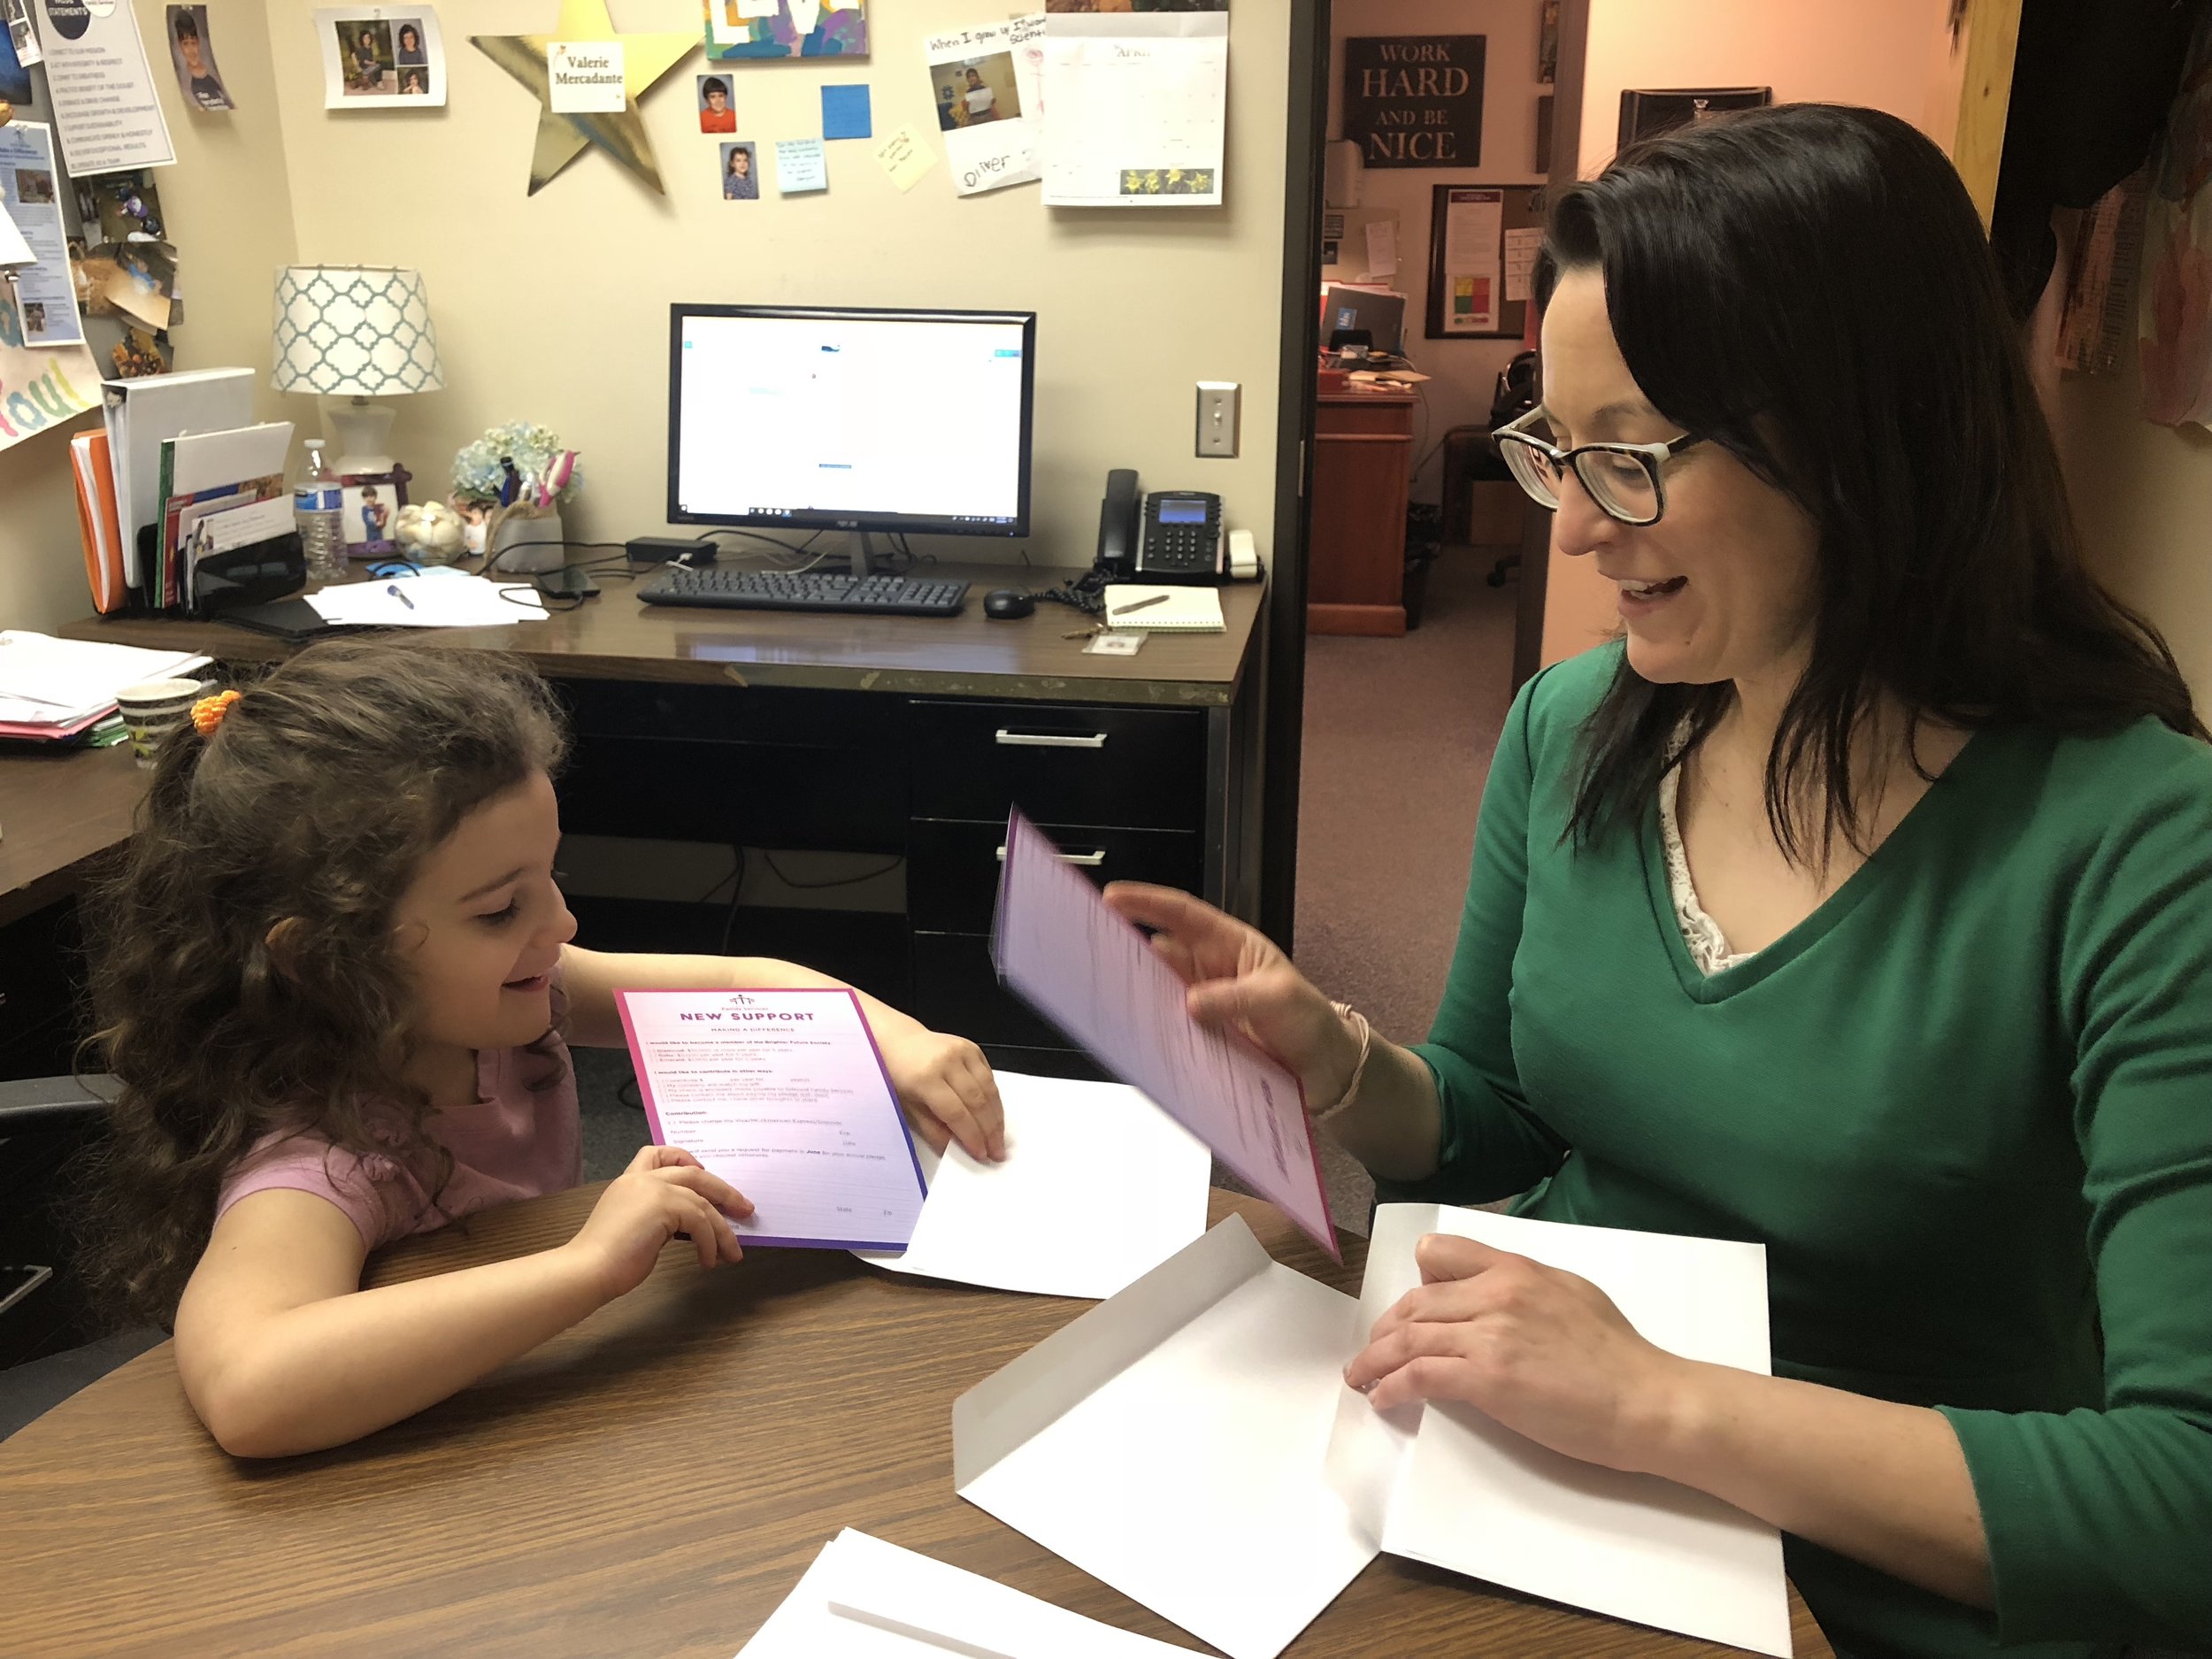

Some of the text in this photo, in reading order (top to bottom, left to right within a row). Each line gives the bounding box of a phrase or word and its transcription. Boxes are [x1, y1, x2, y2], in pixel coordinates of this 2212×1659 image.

[567, 56, 610, 68] Valerie
[1379, 44, 1451, 63] WORK
[556, 72, 624, 85] Mercadante
[1360, 66, 1470, 97] HARD
[1376, 109, 1448, 126] AND BE
[1368, 132, 1457, 161] NICE
[680, 1012, 814, 1021] NEW SUPPORT
